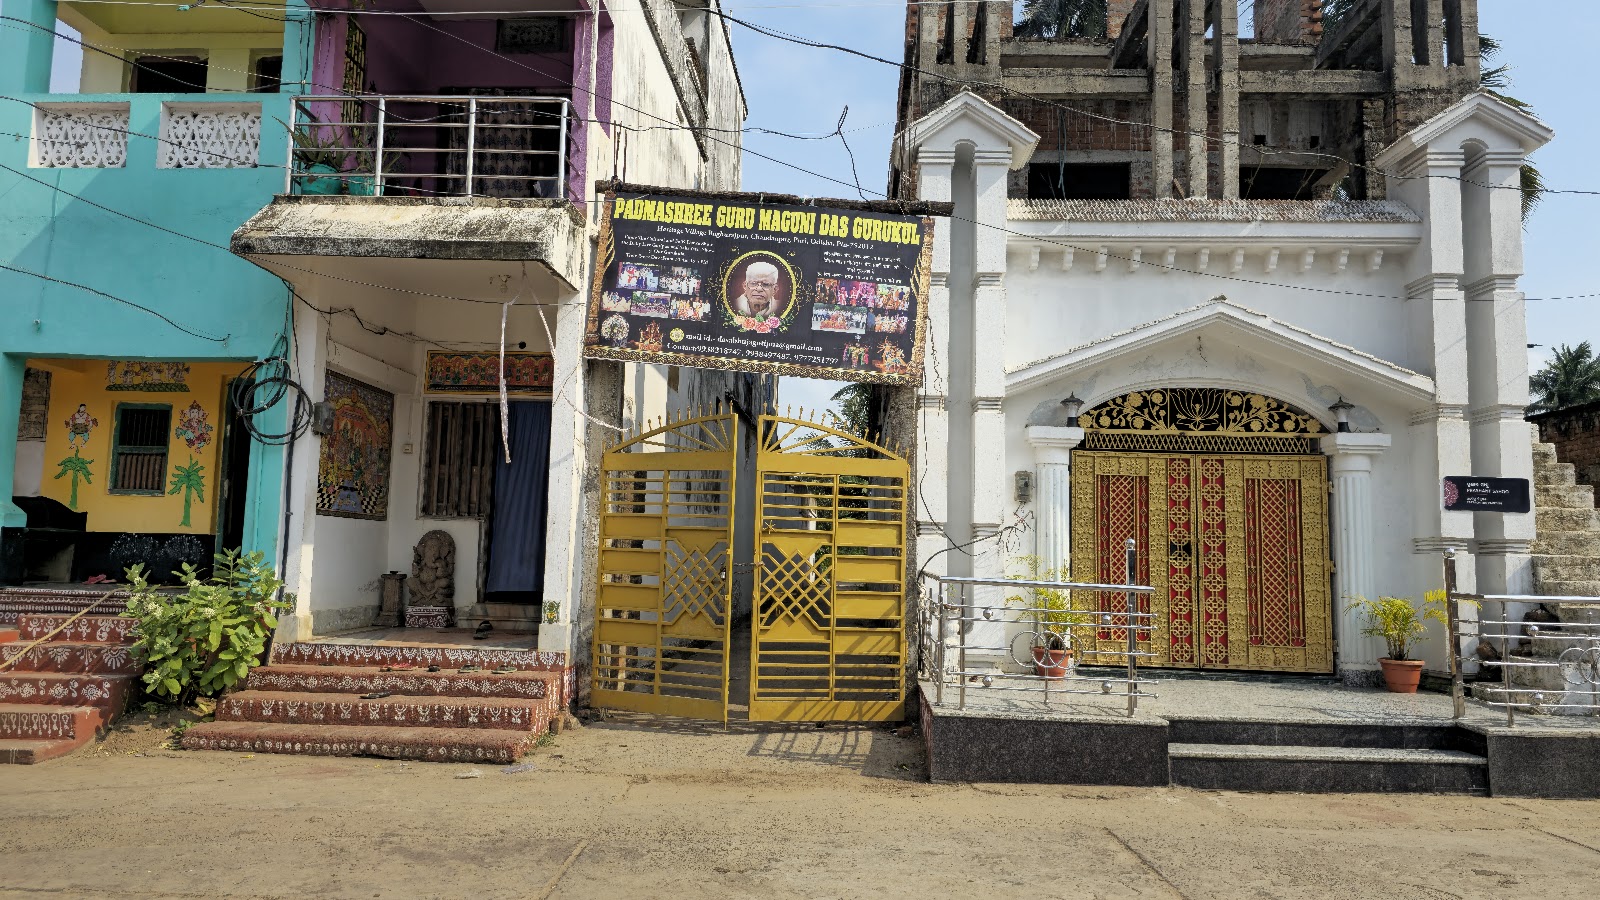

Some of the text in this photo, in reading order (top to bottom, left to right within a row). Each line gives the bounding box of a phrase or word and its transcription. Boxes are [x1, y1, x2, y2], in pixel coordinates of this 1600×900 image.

[613, 197, 921, 245] PADMASHREE GURU MAGUNI DAS GURUKUL
[656, 225, 684, 234] Heritage
[685, 227, 707, 236] Village
